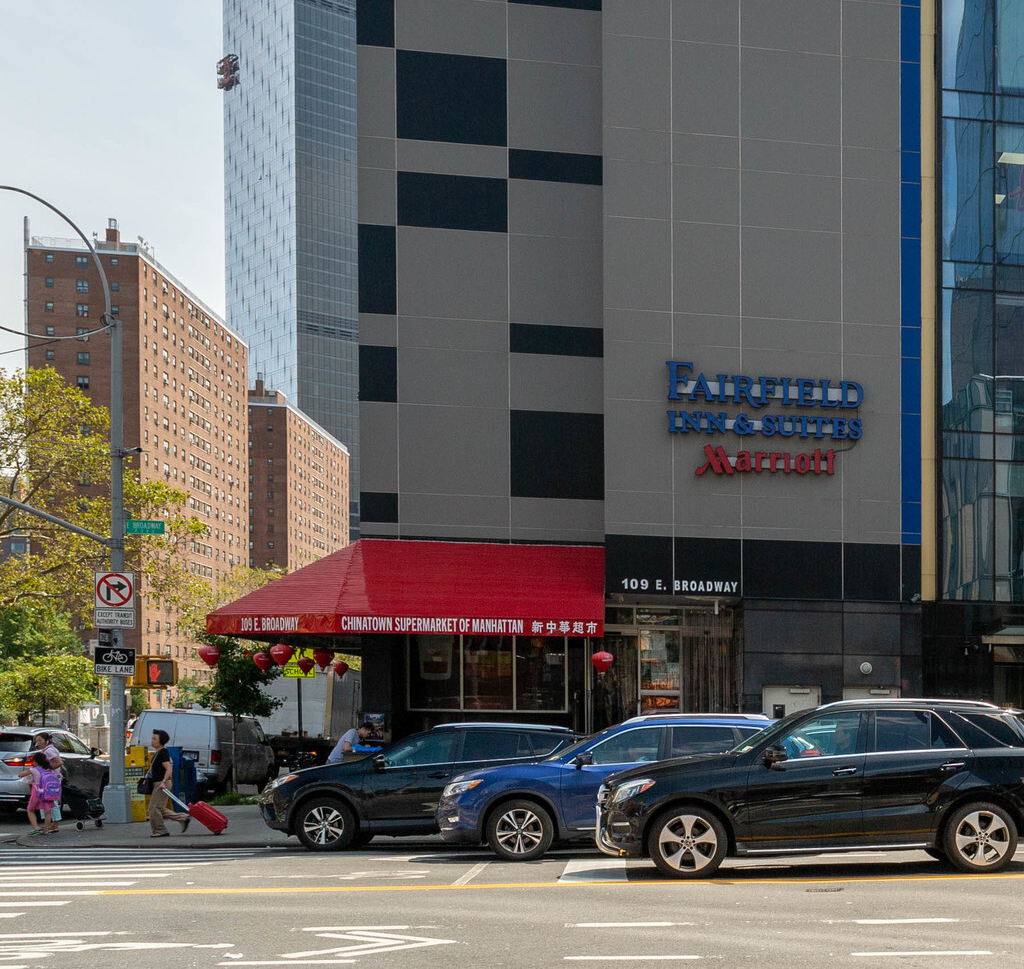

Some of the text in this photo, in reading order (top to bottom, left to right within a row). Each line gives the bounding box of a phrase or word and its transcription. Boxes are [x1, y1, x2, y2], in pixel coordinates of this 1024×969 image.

[665, 361, 864, 408] FAIRFIELD
[667, 411, 863, 440] INN & SUITES
[694, 444, 836, 475] Marriott
[621, 578, 738, 592] 109 E. BROADWAY
[241, 617, 299, 631] 109 E. BROADWAY
[341, 616, 598, 634] CHINATOWN SUPERMARKET OF MANHATTAN 新中華超市
[96, 665, 112, 673] BIKE
